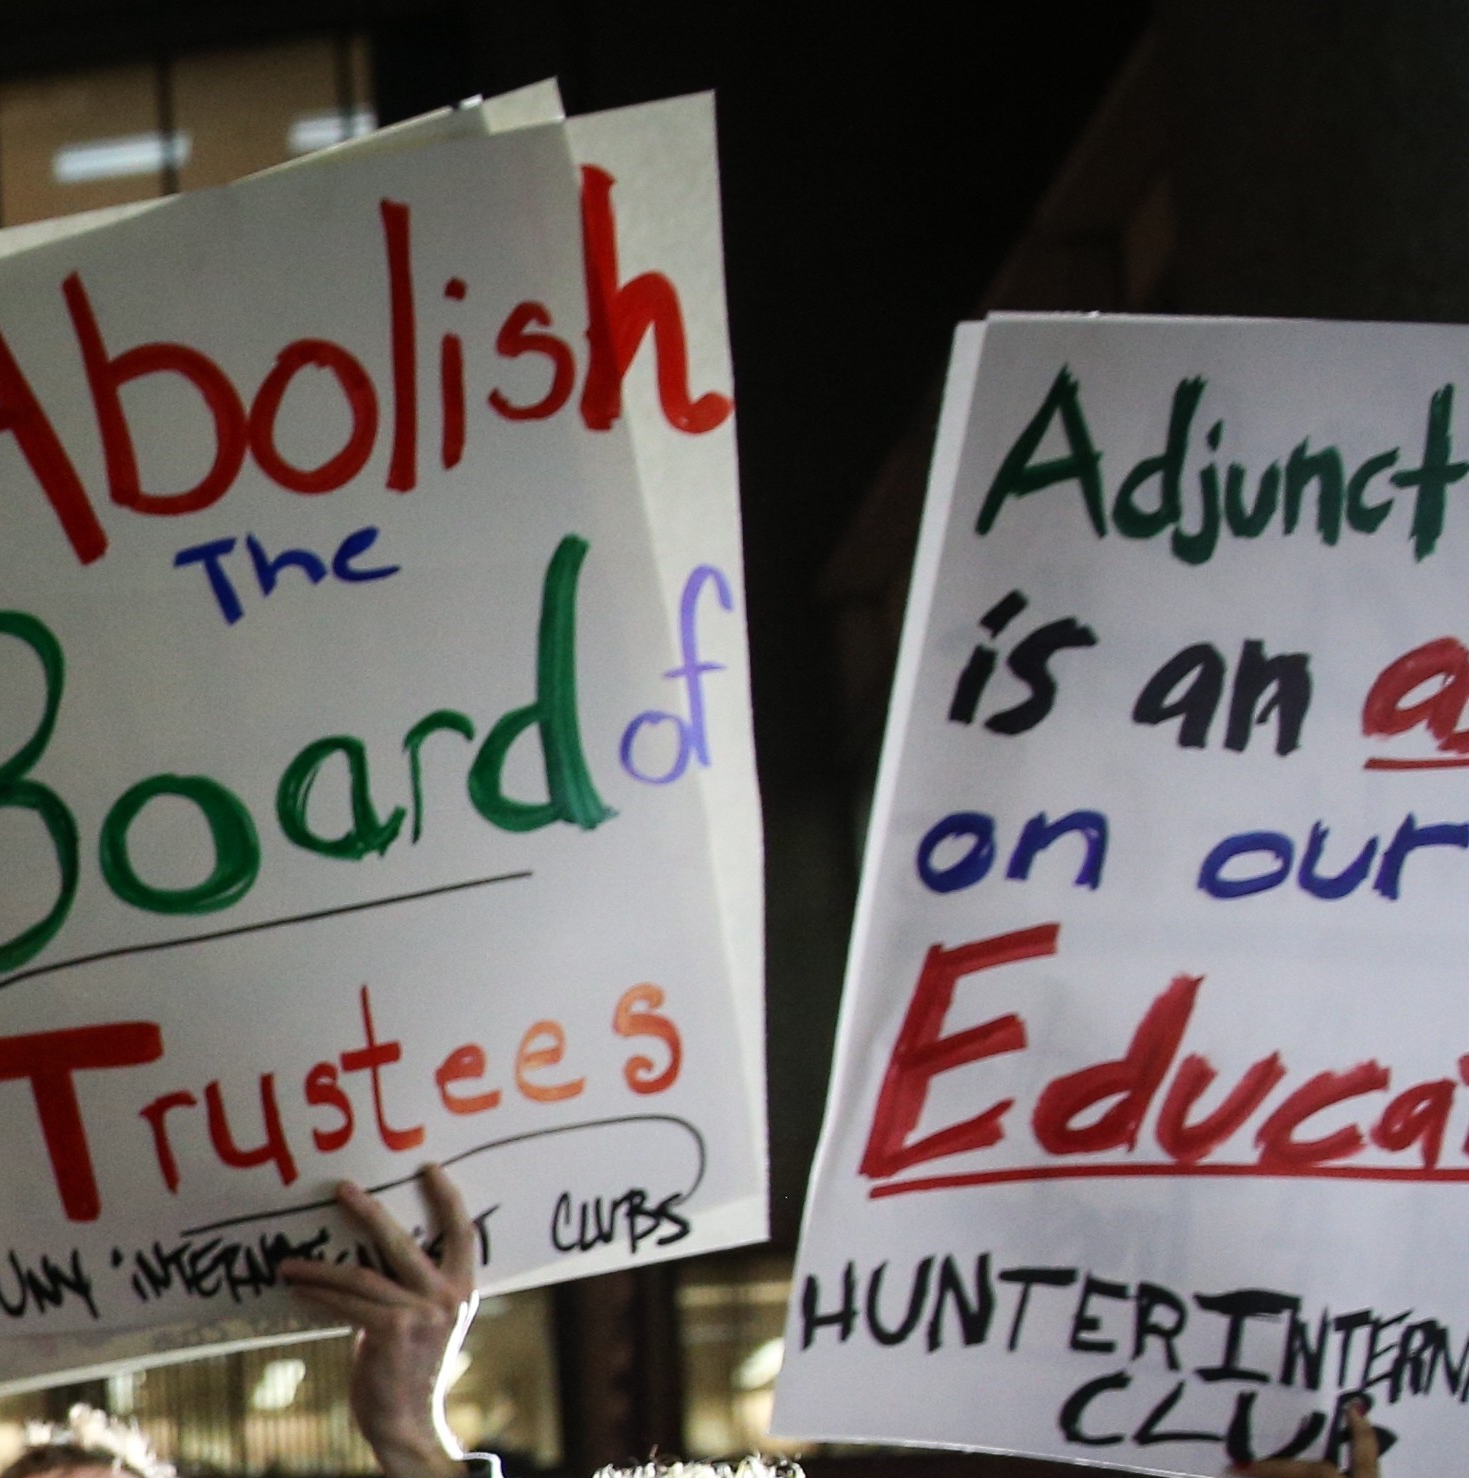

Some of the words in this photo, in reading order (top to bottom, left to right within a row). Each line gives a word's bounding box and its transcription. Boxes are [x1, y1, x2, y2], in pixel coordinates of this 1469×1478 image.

[174, 526, 401, 625] The
[620, 561, 734, 785] of
[949, 589, 1098, 736] is
[1132, 637, 1313, 756] an
[917, 809, 1109, 894] on
[1197, 811, 1469, 901] our
[859, 923, 1469, 1172] Educa
[551, 1188, 692, 1255] CLUBS
[801, 1252, 1187, 1372] HUNTER
[1192, 1287, 1469, 1404] INTERN
